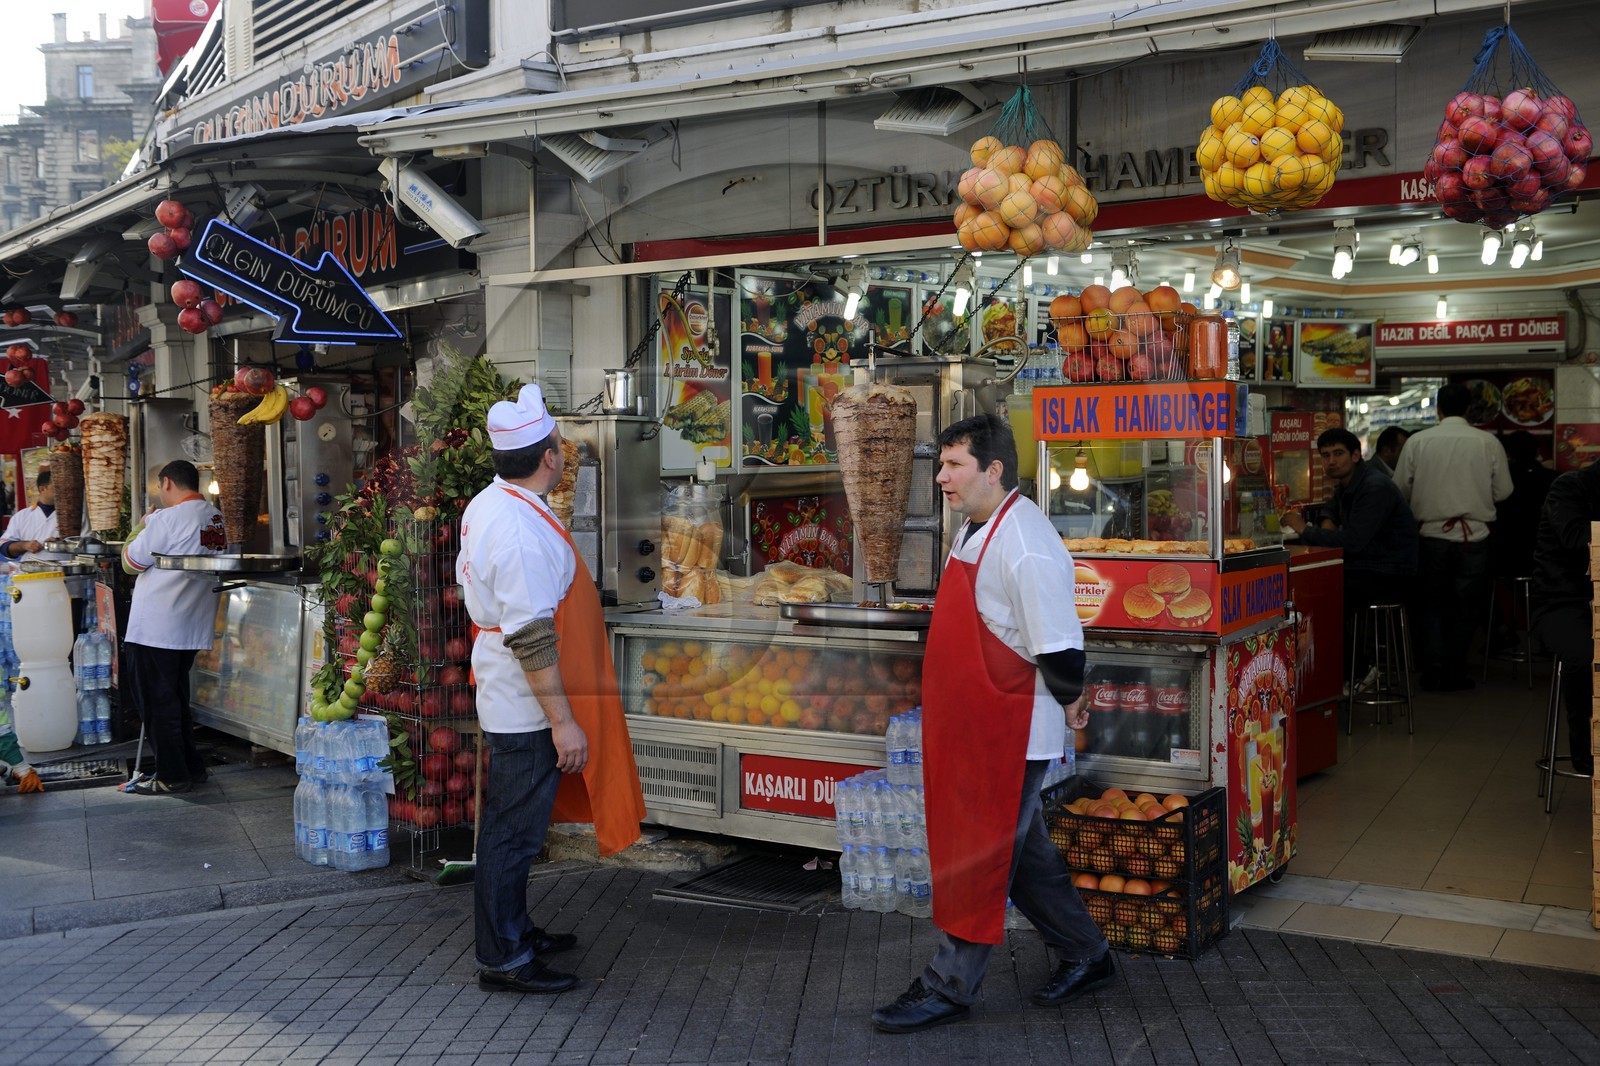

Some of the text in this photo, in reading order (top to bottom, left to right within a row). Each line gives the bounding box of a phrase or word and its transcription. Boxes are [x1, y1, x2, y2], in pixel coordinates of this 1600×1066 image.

[1381, 320, 1559, 341] HAZIR DEĞİL PARÇA ET DÖNER
[1042, 396, 1100, 434] ISLAK
[1280, 418, 1302, 430] KAŞARLI
[820, 529, 838, 551] BAR
[745, 772, 838, 804] KAŞARLI DÜ
